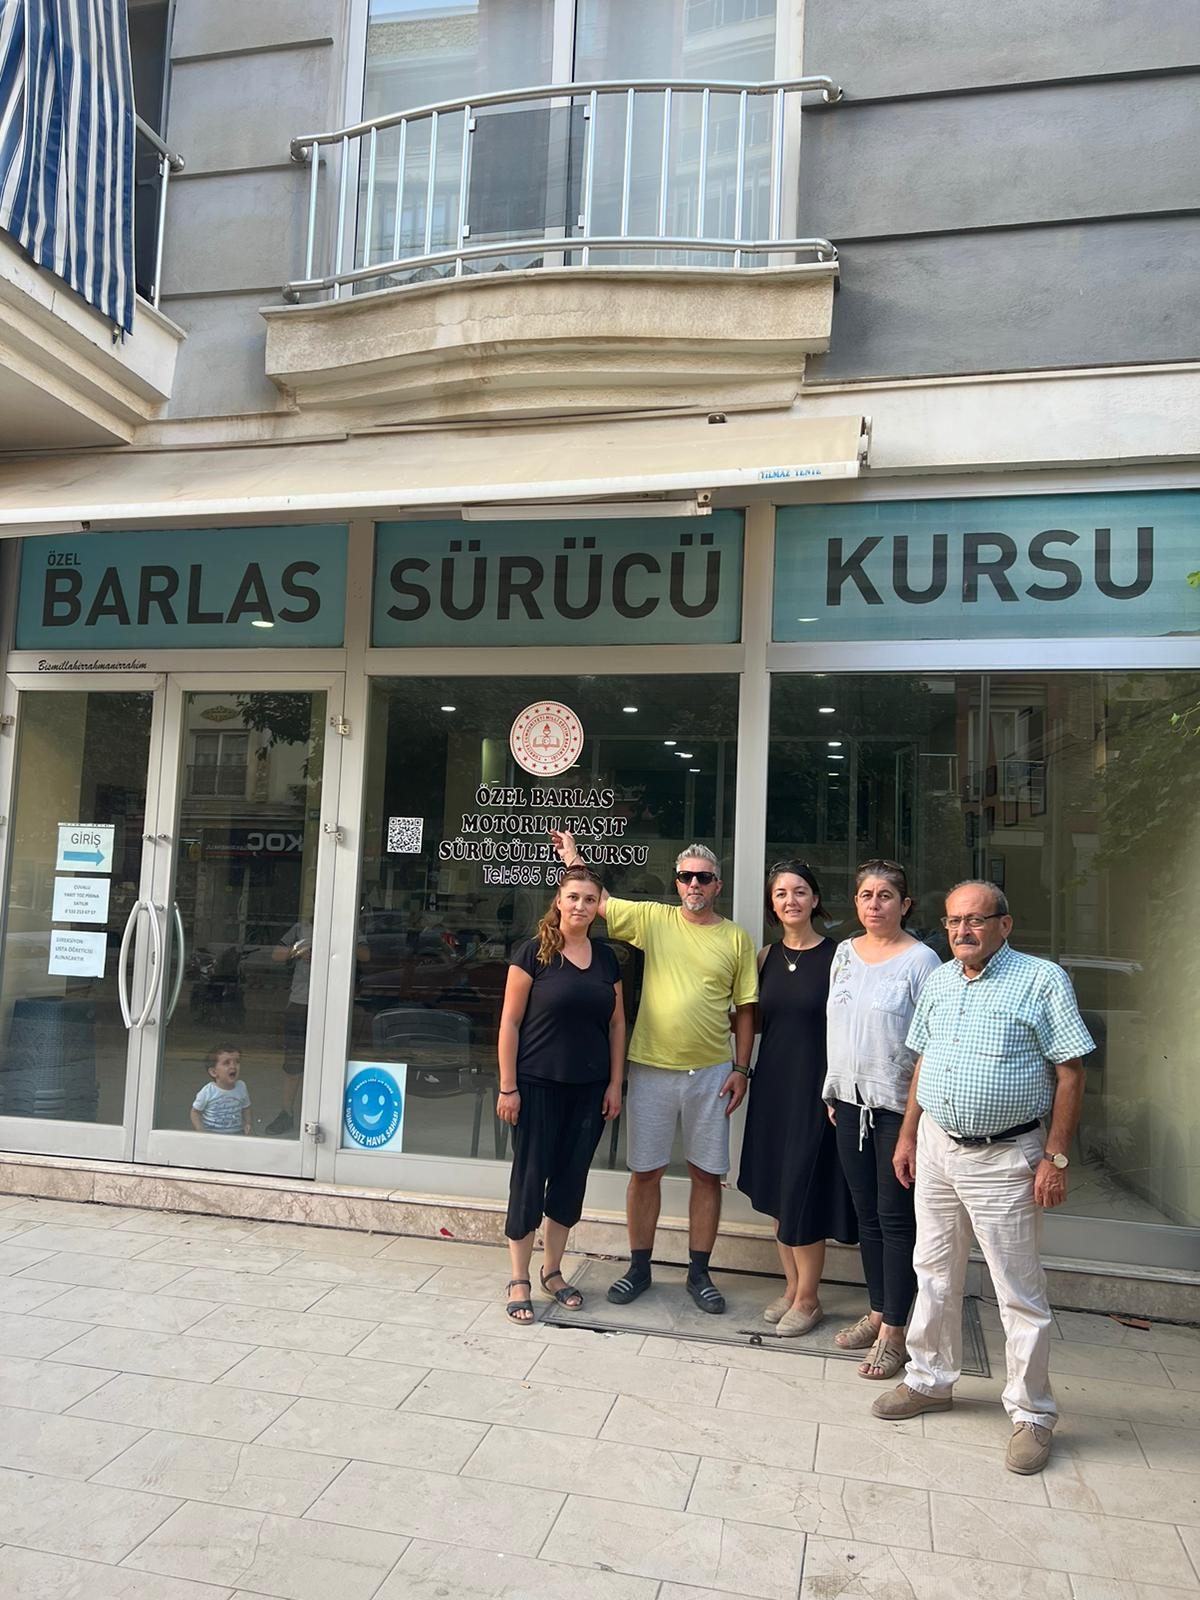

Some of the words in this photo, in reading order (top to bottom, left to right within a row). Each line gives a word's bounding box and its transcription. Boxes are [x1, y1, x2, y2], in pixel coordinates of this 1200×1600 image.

[47, 550, 81, 566] ÖZEL
[42, 561, 321, 627] BARLAS
[387, 533, 721, 621] SÜRÜCÜ
[826, 526, 1154, 606] KURSU
[475, 783, 527, 807] ÖZEL
[530, 787, 615, 808] BARLAS
[461, 814, 562, 835] MOTORLU
[565, 815, 628, 841] TAŞIT
[71, 832, 101, 848] GİRİŞ
[438, 837, 566, 863] SÜRÜCÜLER
[575, 844, 649, 866] KURSU
[483, 865, 542, 885] Tel:585
[366, 1133, 387, 1146] HAVA
